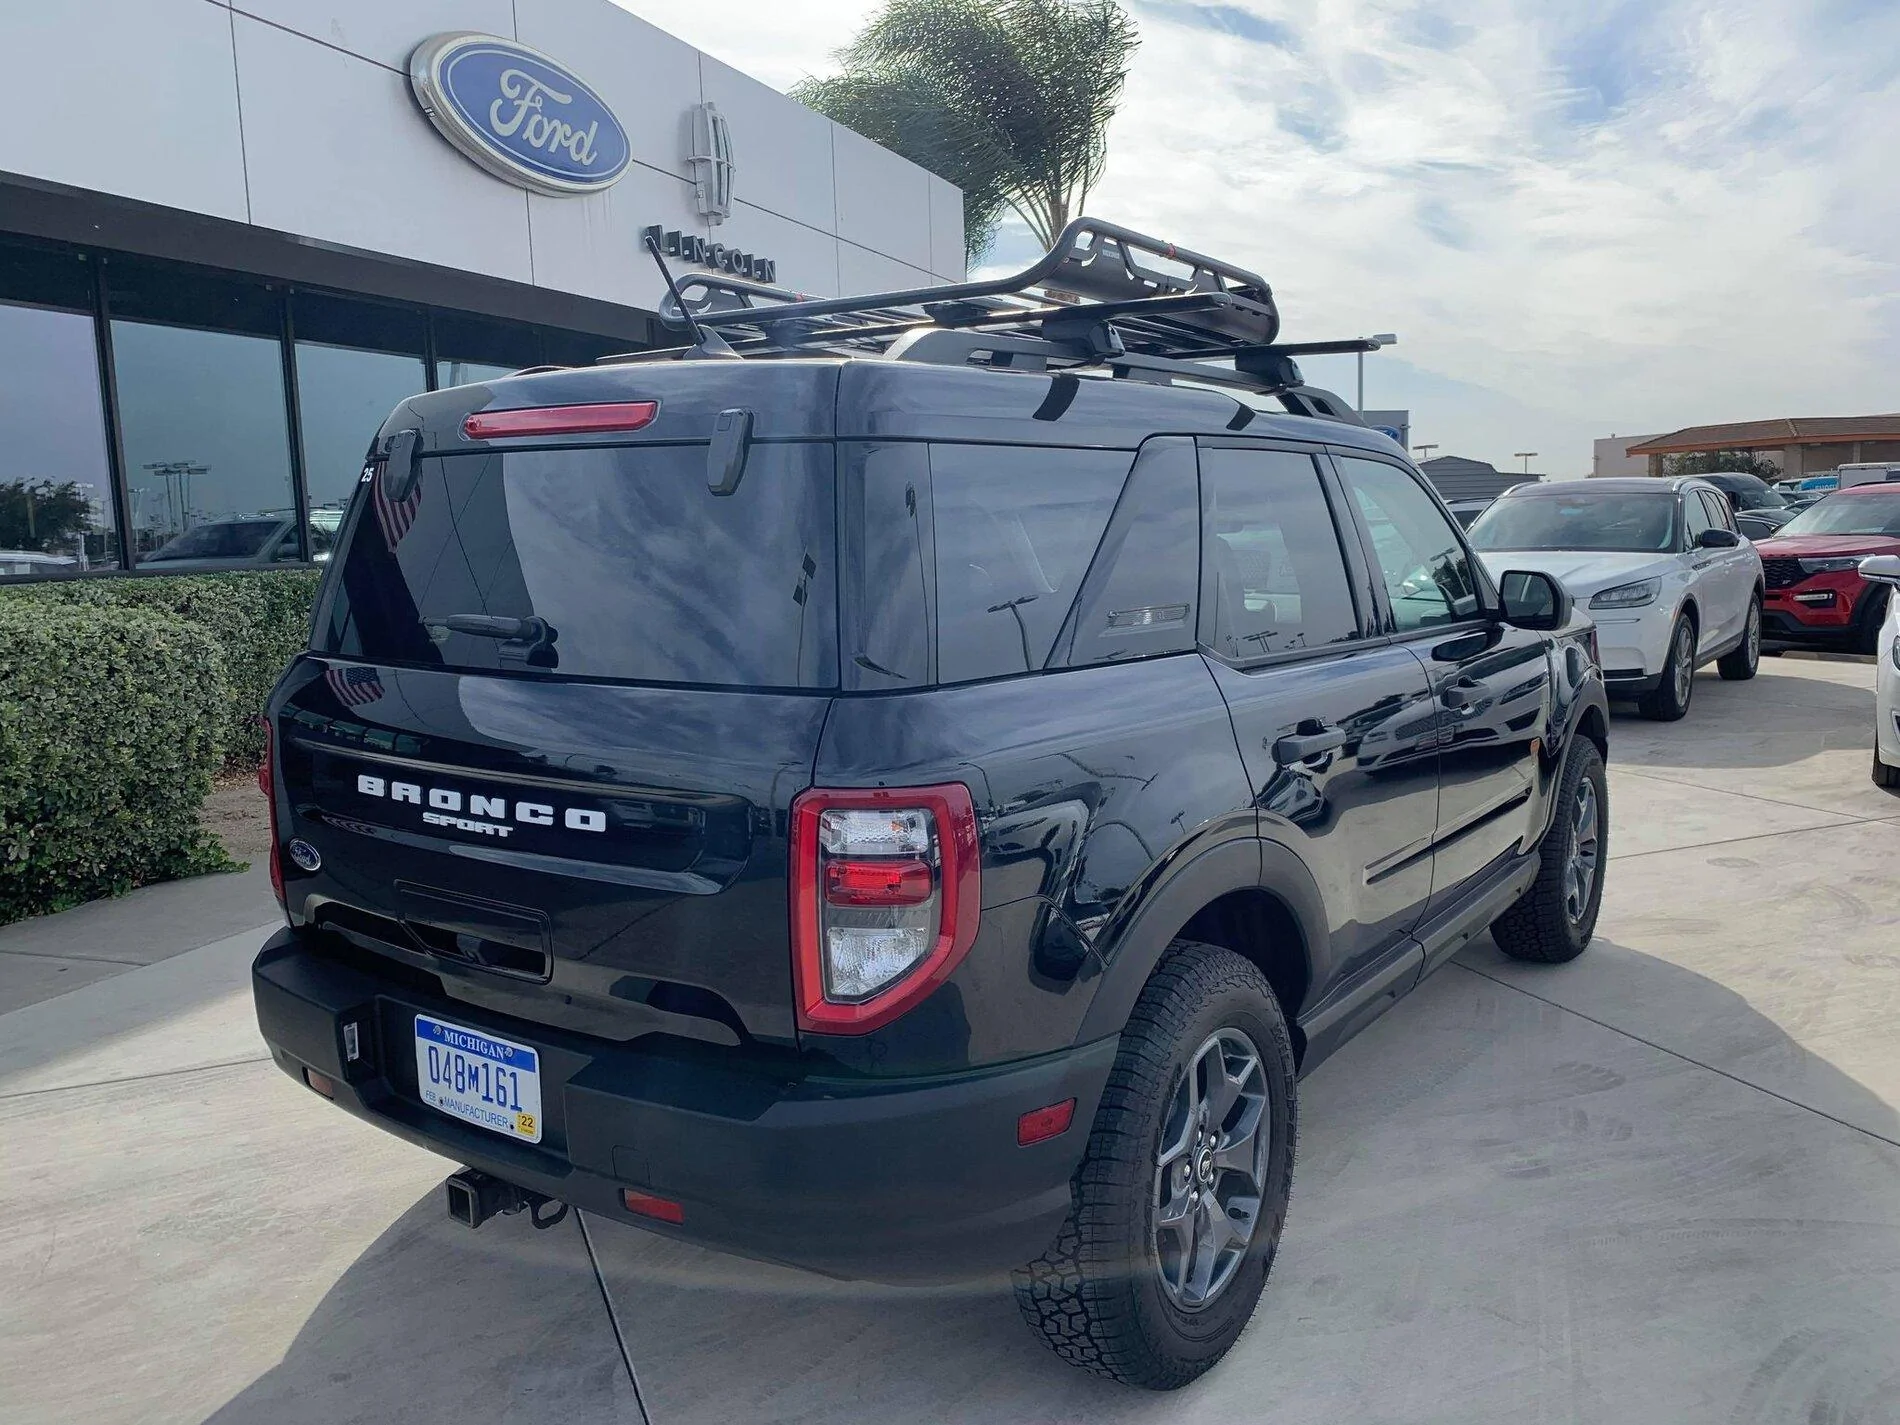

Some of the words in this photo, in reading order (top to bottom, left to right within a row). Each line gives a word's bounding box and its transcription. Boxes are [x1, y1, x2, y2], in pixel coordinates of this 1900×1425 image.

[489, 68, 598, 166] Ford
[643, 225, 776, 283] LINCOLN
[361, 467, 375, 483] 25
[357, 774, 606, 833] BRONCO
[422, 811, 514, 838] SPORT
[443, 1029, 505, 1059] MICHIGAN
[428, 1046, 522, 1112] 048M161
[444, 1096, 508, 1128] MANUFACTURER
[521, 1115, 534, 1128] 22
